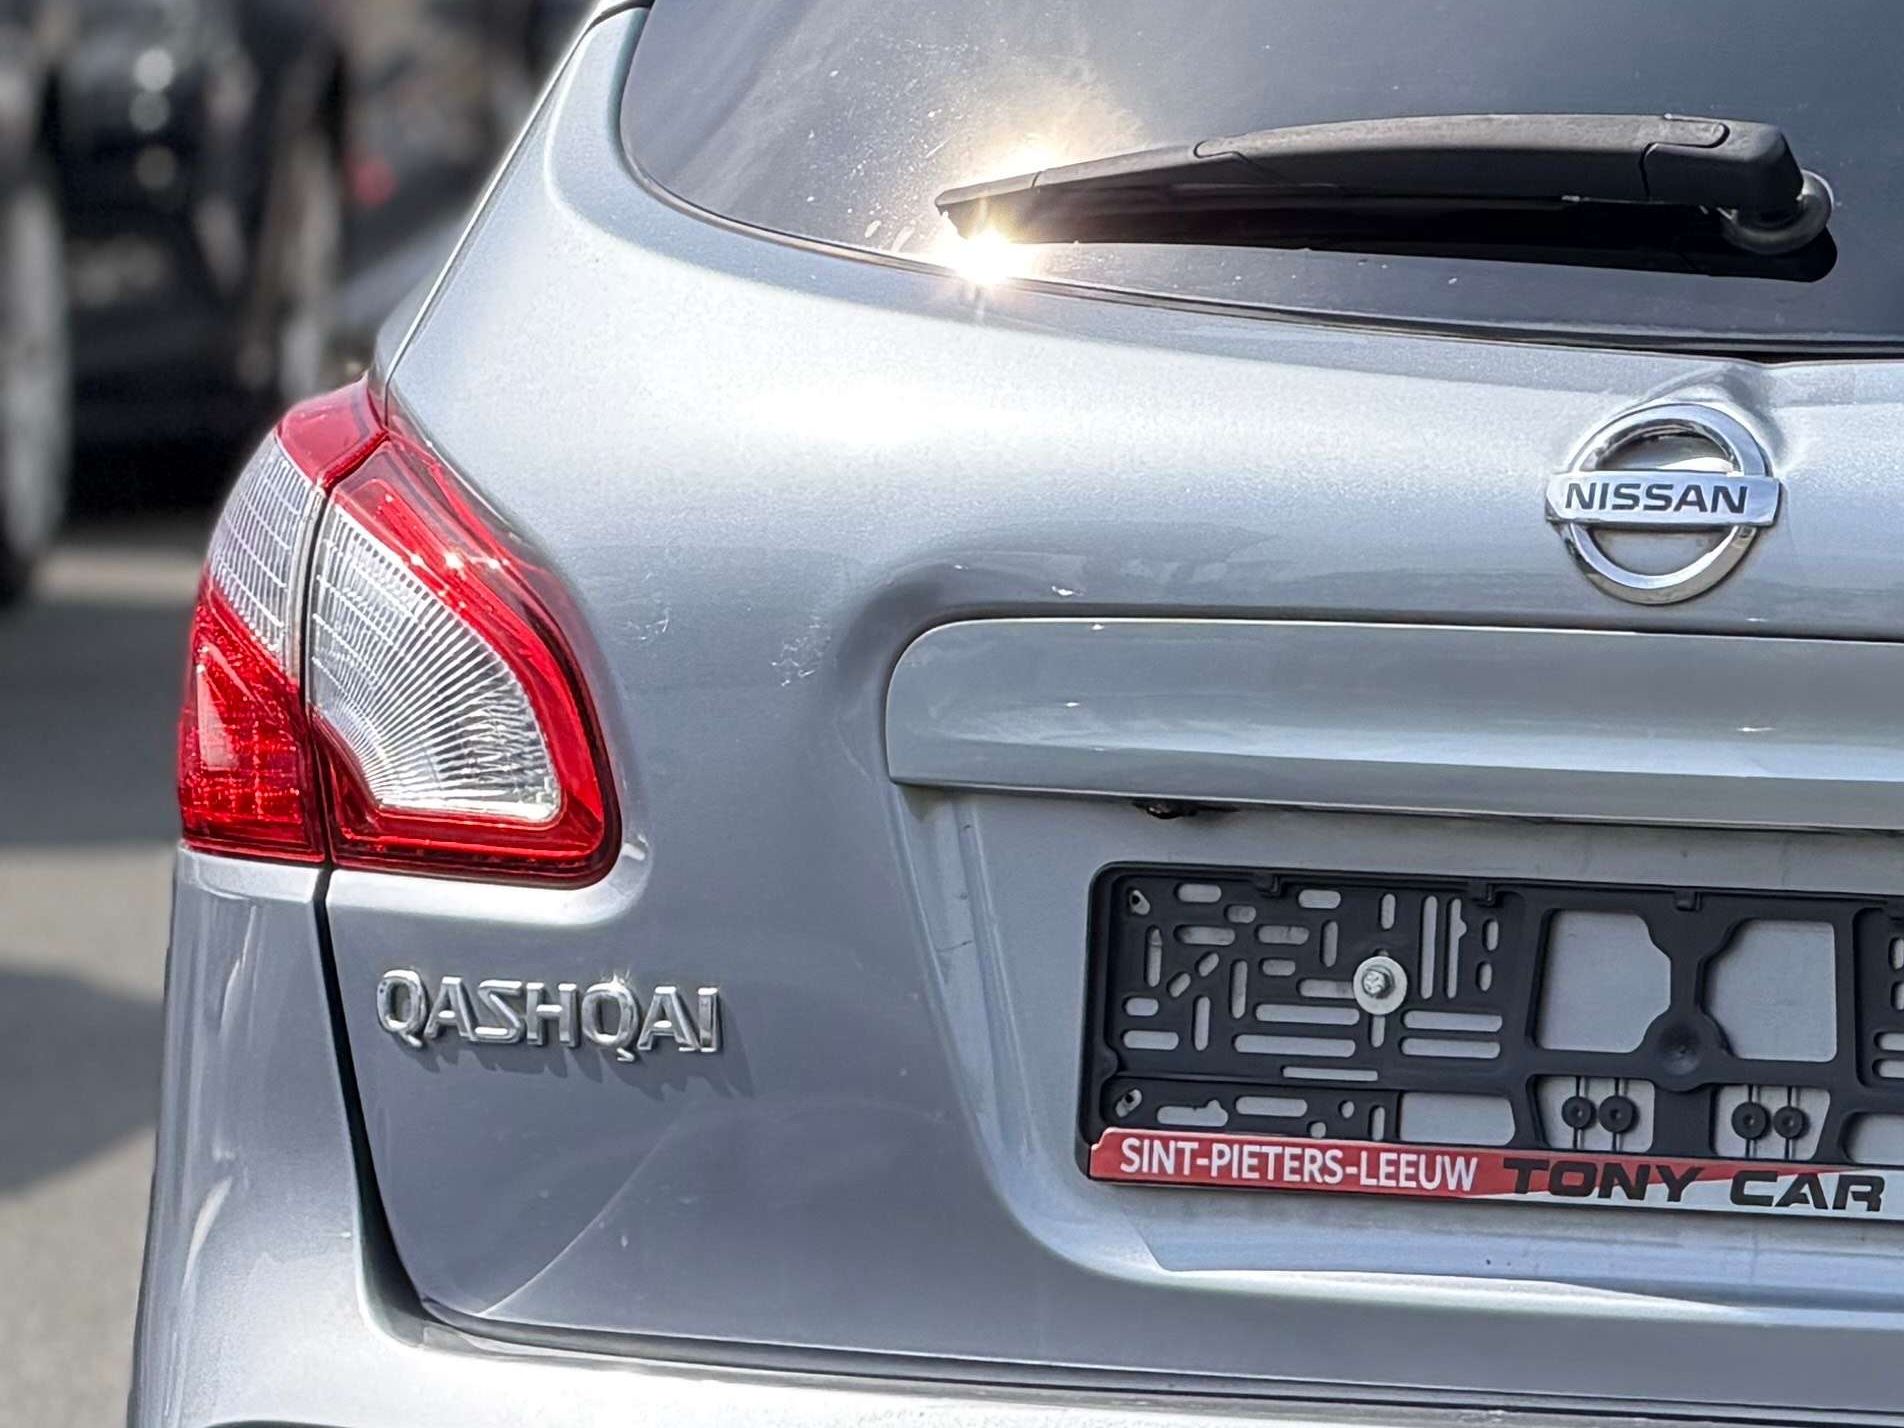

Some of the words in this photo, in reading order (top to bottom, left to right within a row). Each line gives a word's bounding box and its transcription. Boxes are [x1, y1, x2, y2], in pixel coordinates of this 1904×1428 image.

[1564, 482, 1748, 515] NISSAN
[375, 968, 725, 1063] QASHQAI
[1119, 1136, 1479, 1193] SINT-PIETERS-LEEUW
[1502, 1157, 1705, 1203] TONY
[1729, 1171, 1886, 1212] CAR
